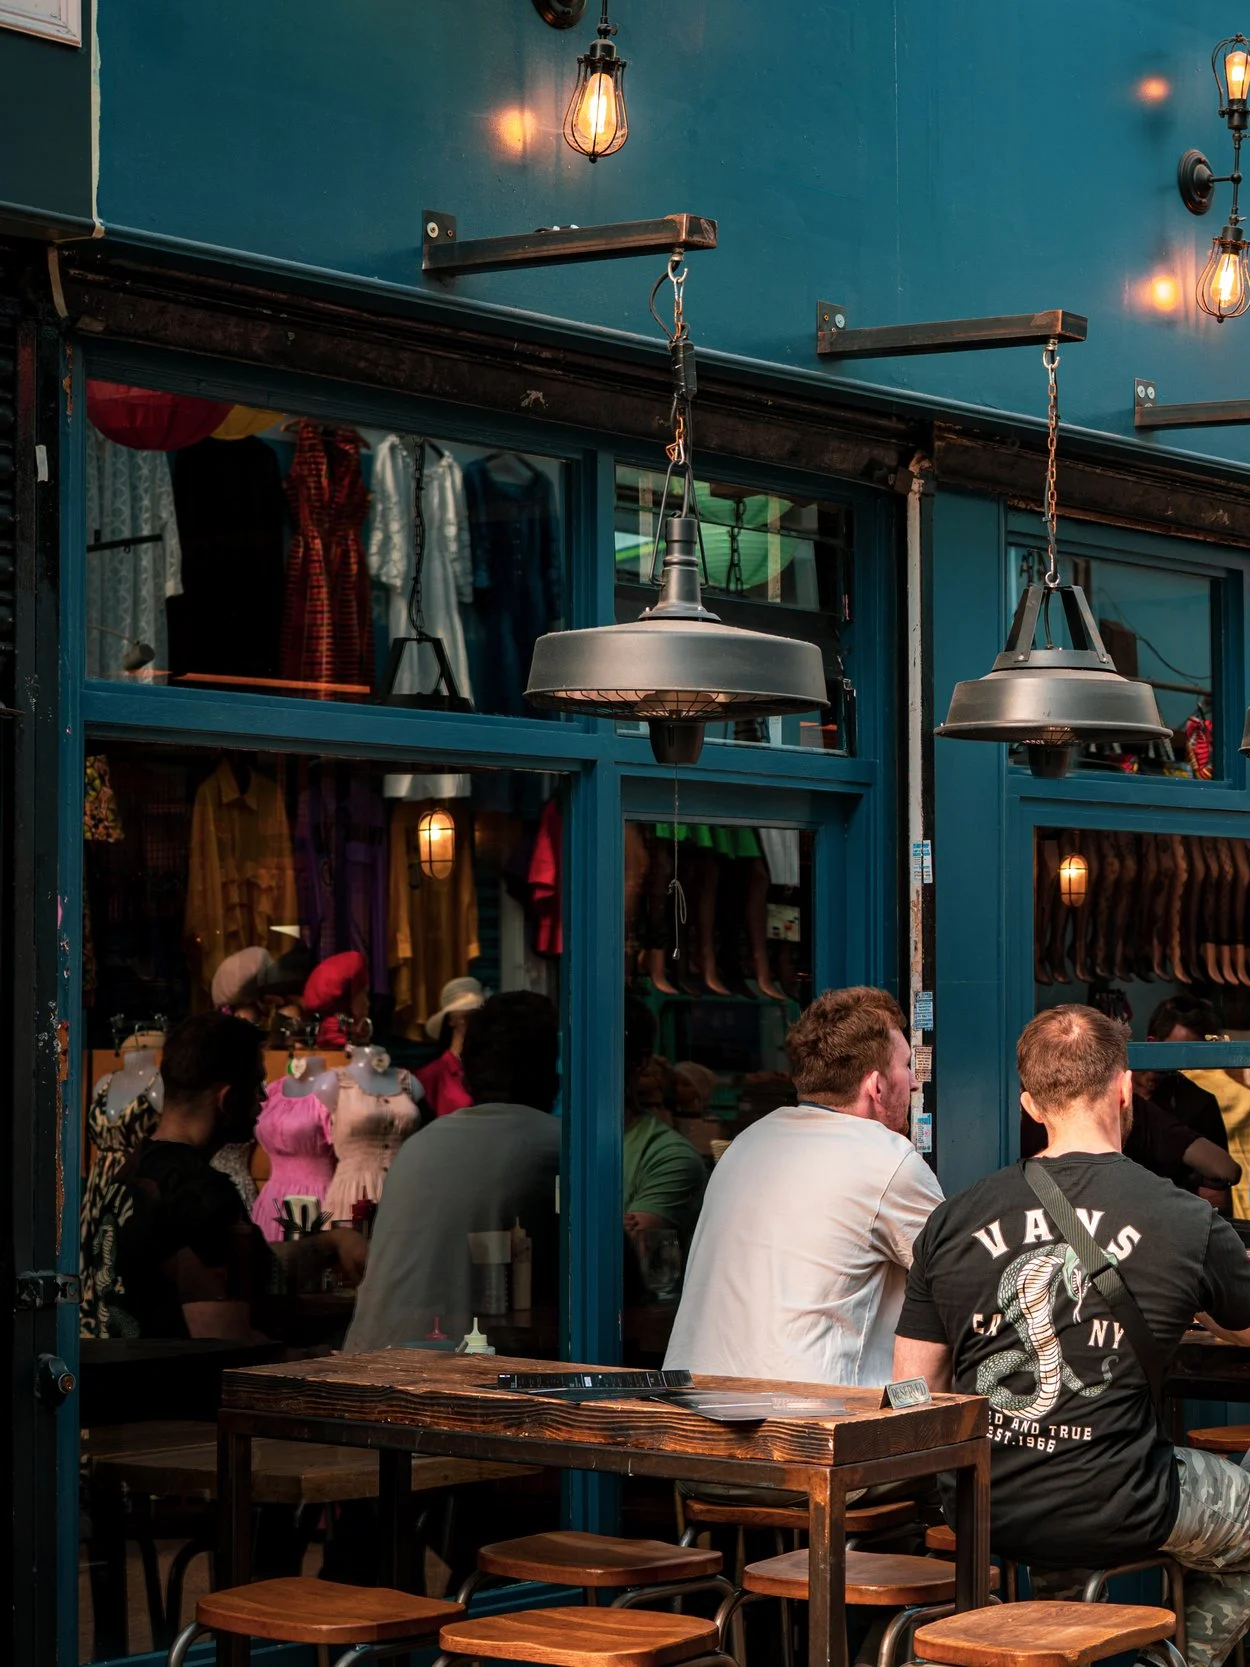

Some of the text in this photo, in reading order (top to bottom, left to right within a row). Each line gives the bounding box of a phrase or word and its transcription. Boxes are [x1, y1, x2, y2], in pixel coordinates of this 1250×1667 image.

[971, 1207, 1143, 1262] VANS
[1087, 1318, 1125, 1350] NY
[986, 1424, 1057, 1454] EST.1966
[1010, 1417, 1040, 1435] AND
[1048, 1424, 1093, 1442] TRUE
